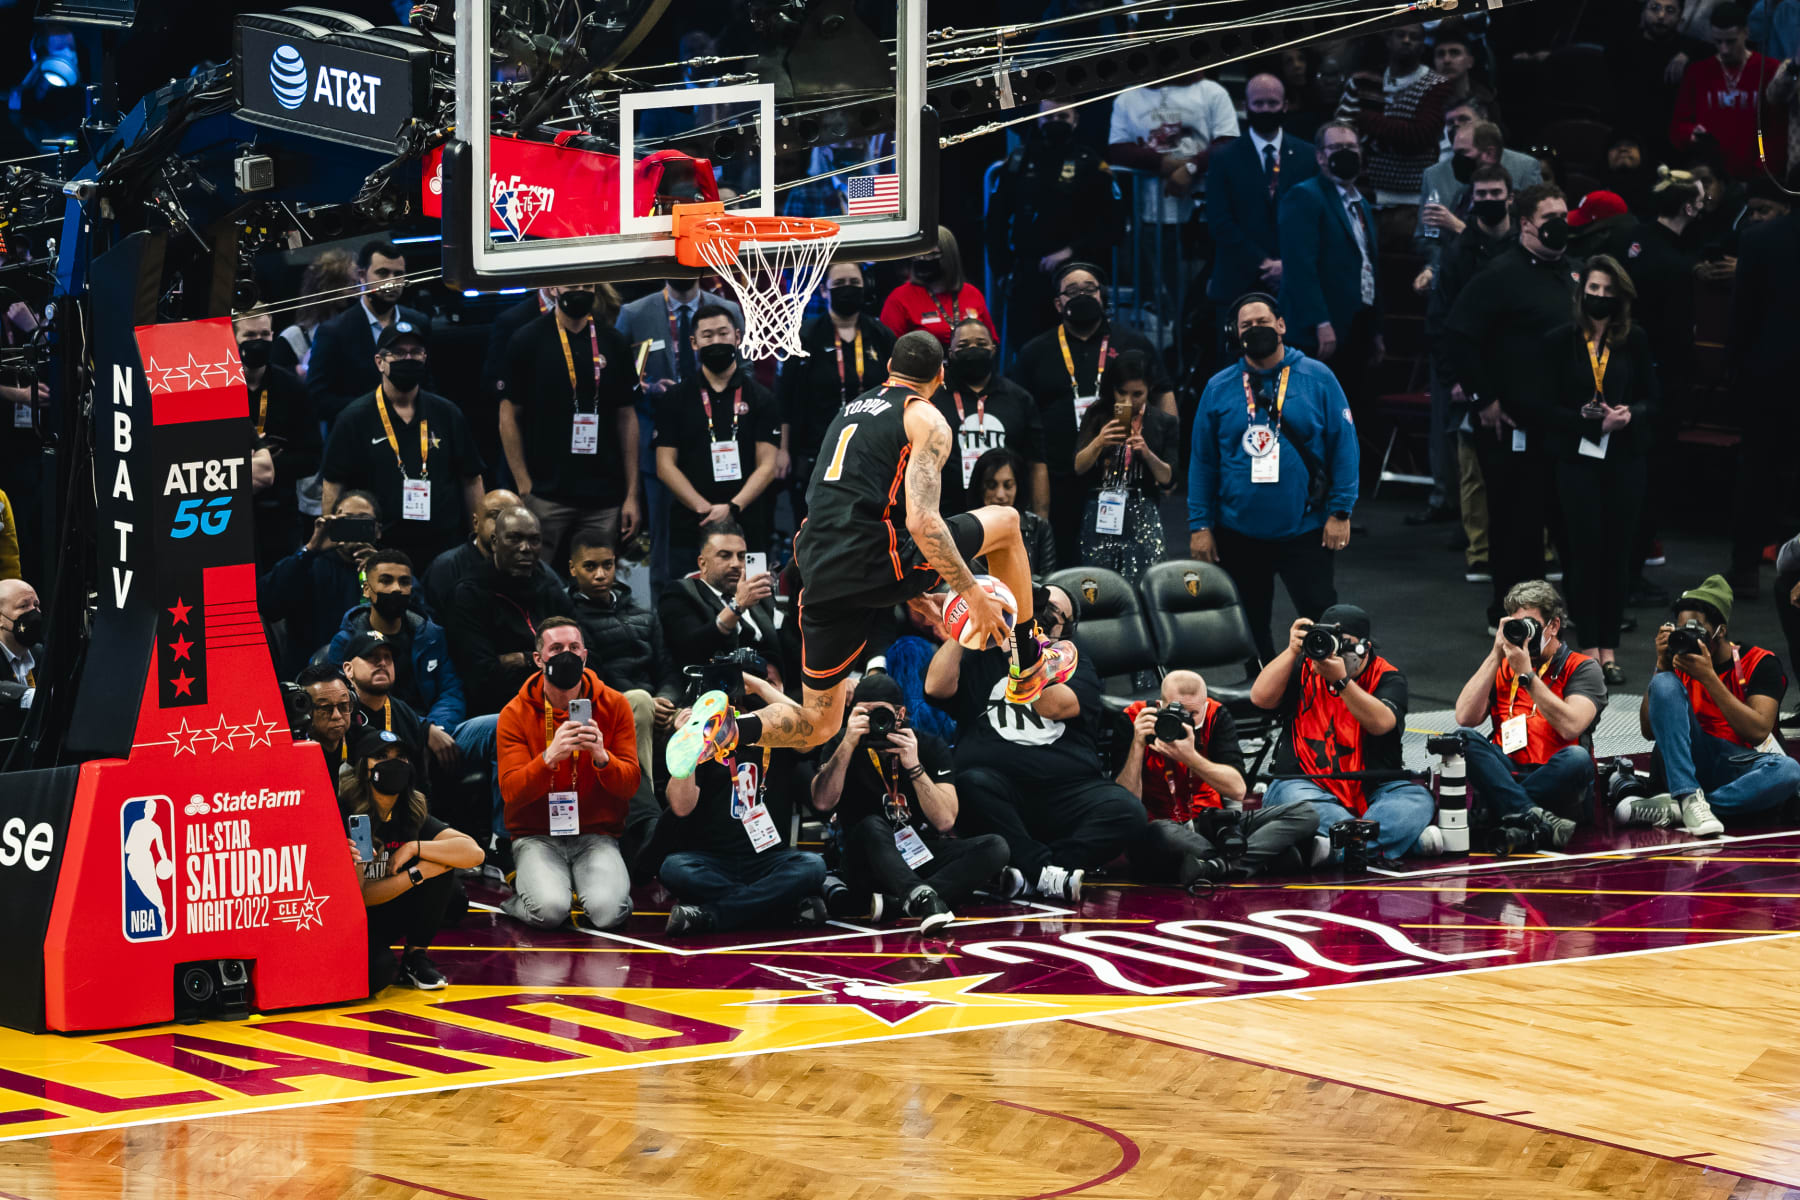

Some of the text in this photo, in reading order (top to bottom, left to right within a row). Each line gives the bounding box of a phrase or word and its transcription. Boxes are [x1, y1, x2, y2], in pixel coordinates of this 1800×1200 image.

[313, 65, 382, 115] AT&T
[522, 196, 533, 213] 75
[823, 423, 859, 481] 1
[112, 364, 134, 610] NBA TV
[163, 457, 245, 496] AT&T
[169, 496, 233, 539] 5G
[987, 696, 1046, 731] TN
[186, 844, 307, 902] SATURDAY
[130, 908, 156, 933] NBA
[278, 902, 298, 916] CLE
[960, 908, 1518, 995] 2022
[0, 992, 745, 1126] LAND
